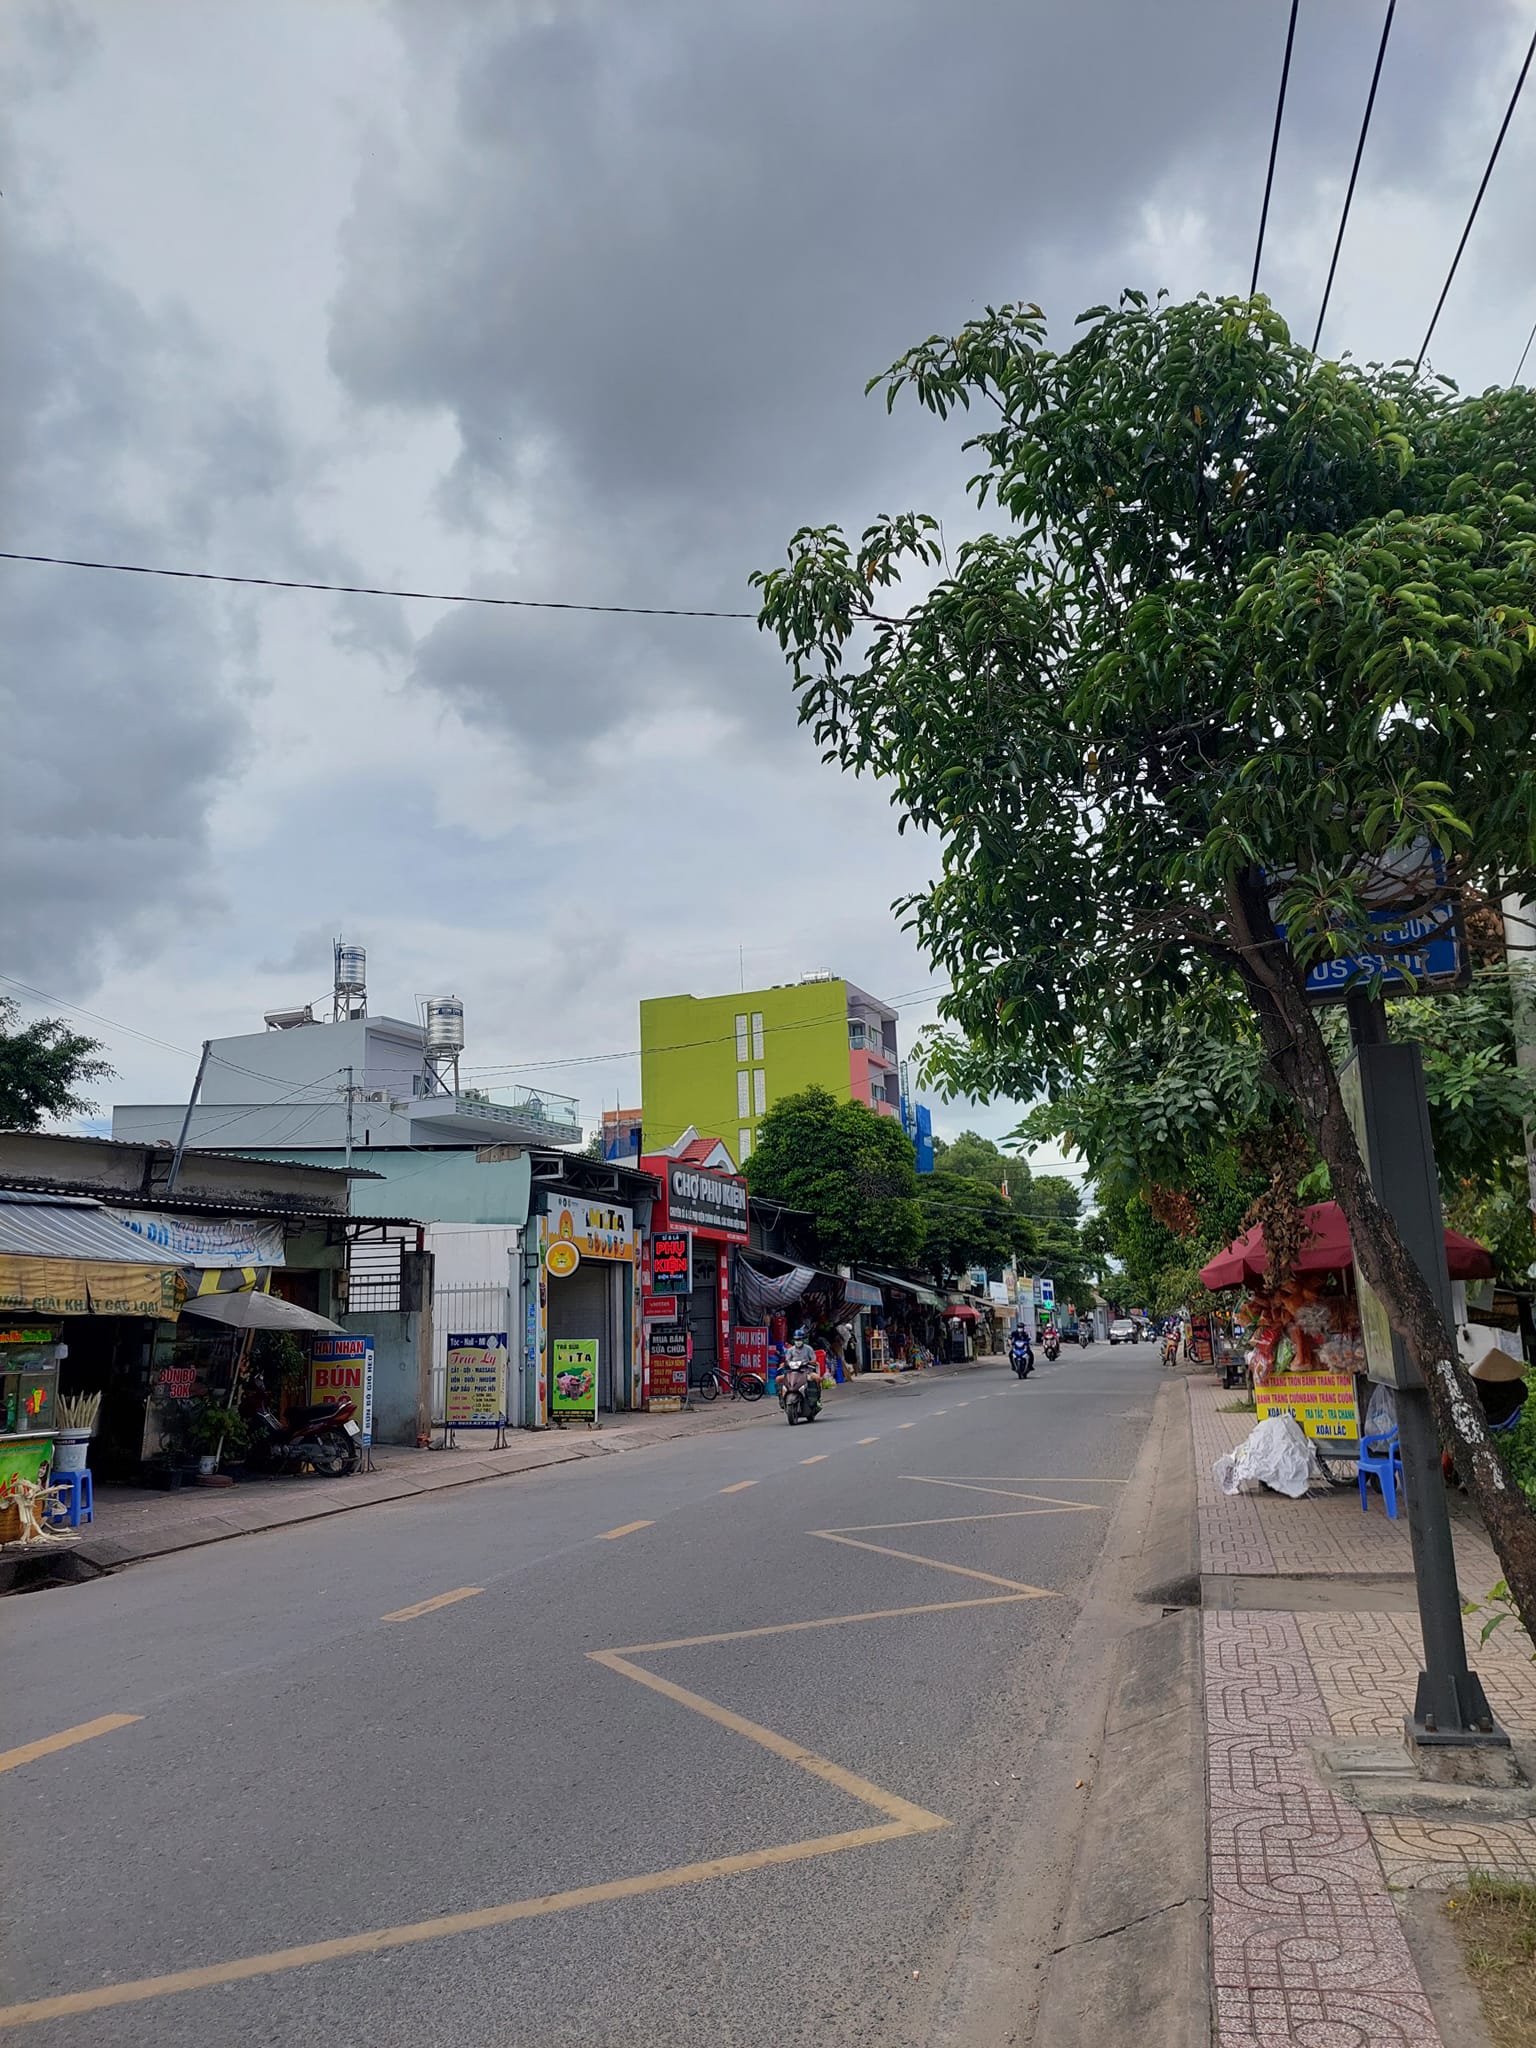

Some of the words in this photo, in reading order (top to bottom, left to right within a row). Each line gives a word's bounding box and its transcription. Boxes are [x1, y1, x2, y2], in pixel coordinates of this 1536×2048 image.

[1312, 957, 1348, 981] US
[673, 1171, 699, 1205] CHỢ
[699, 1177, 722, 1210] PHỤ
[722, 1180, 746, 1214] KIỆN
[655, 1240, 685, 1257] PHỤ
[654, 1255, 688, 1275] KIỆN
[652, 1336, 668, 1344] MUA
[669, 1335, 684, 1343] BÁN
[736, 1331, 750, 1348] PHỤ
[751, 1330, 766, 1348] KIỆN
[315, 1341, 333, 1355] HAI
[335, 1340, 365, 1357] NHẬN
[651, 1344, 665, 1353] SỬA
[666, 1344, 686, 1353] CHỮA
[160, 1365, 181, 1384] BÚN
[182, 1364, 196, 1383] BÒ
[315, 1365, 361, 1388] BÚN
[170, 1383, 190, 1398] 30K
[1316, 1422, 1331, 1435] XOÀI
[1333, 1421, 1347, 1436] LẮC
